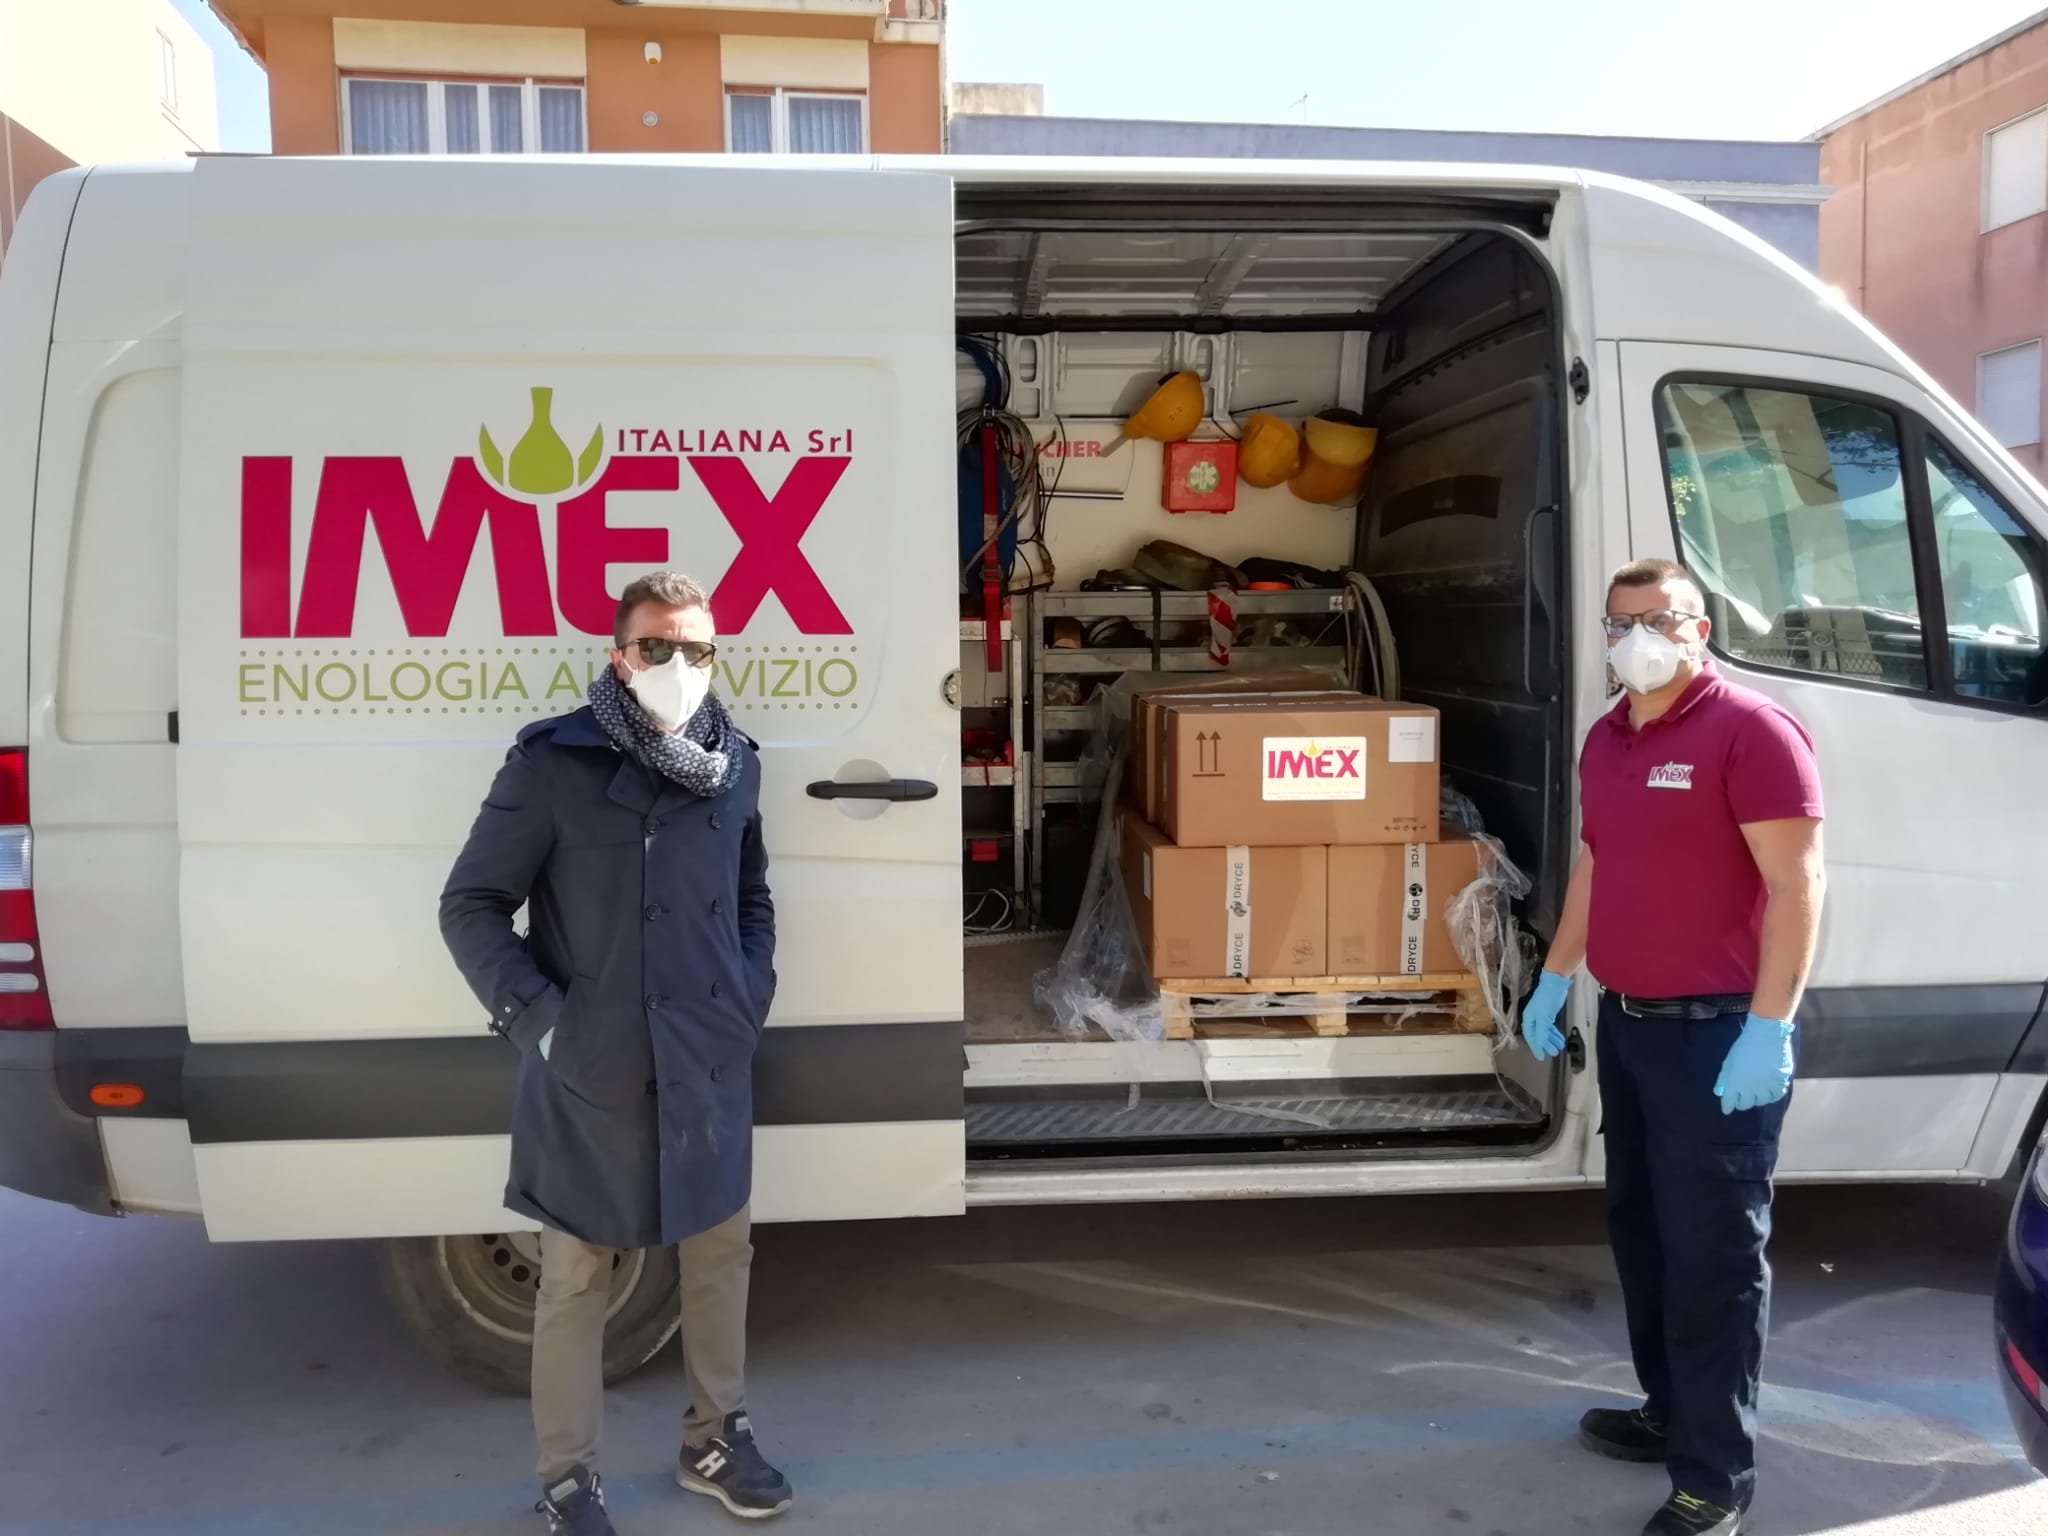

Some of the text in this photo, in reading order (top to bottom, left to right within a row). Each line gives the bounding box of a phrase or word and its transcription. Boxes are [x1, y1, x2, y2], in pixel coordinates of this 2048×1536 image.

[618, 429, 852, 453] ITALIANA Srl
[1014, 440, 1101, 458] CHER
[241, 456, 853, 637] IMEX
[239, 660, 529, 702] ENOLOGIA
[711, 658, 858, 697] VIZIO
[1268, 749, 1360, 778] IMEX
[1649, 766, 1693, 784] IMEX
[1411, 842, 1420, 868] YCE
[1233, 862, 1244, 898] DRYCE
[1233, 933, 1244, 969] DRYCE
[1407, 936, 1417, 972] DRYCE
